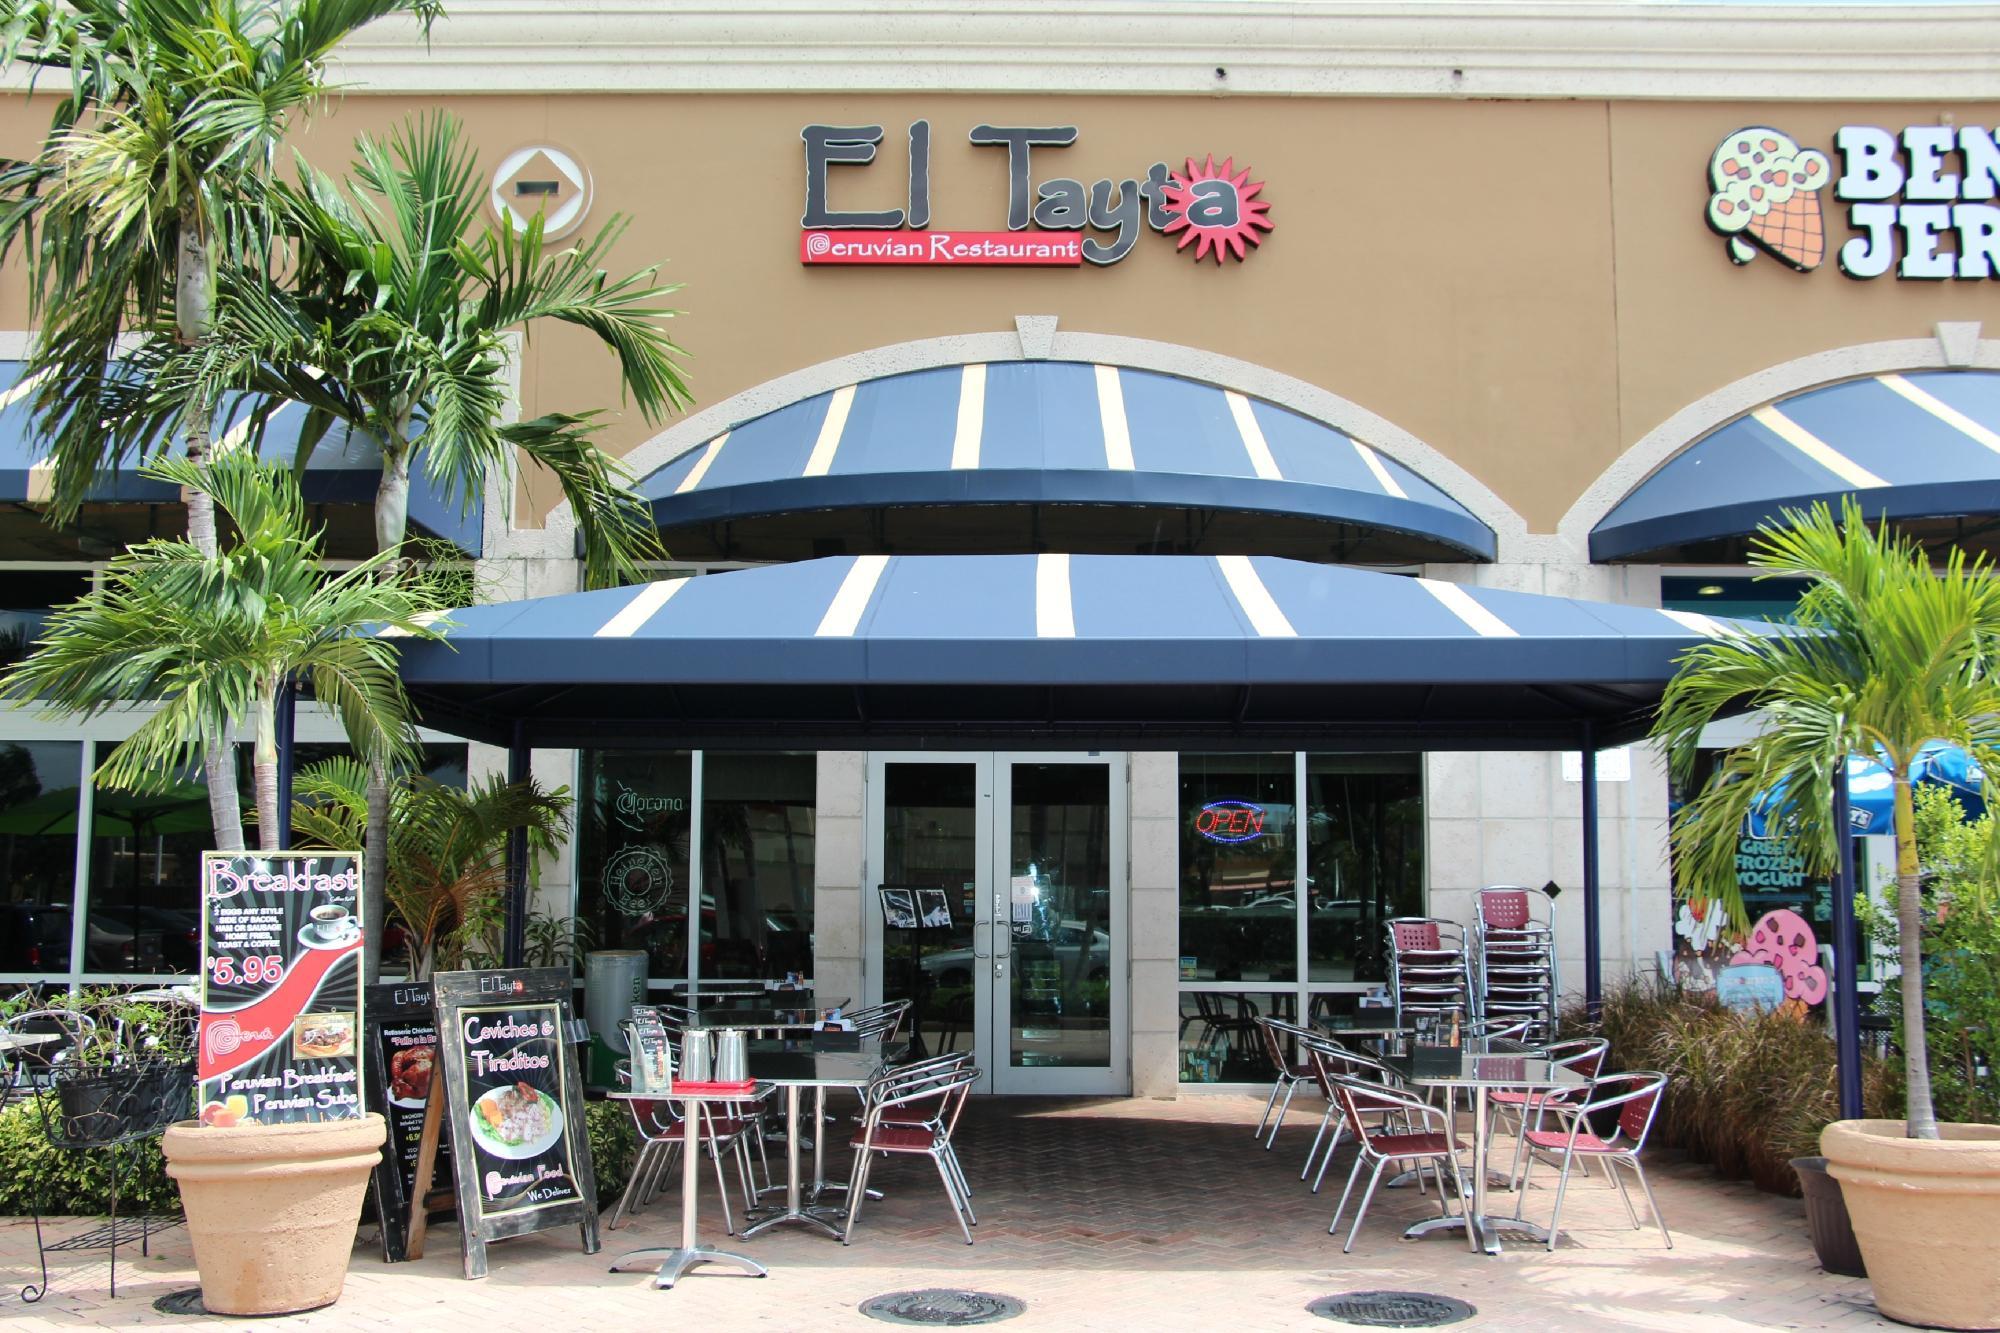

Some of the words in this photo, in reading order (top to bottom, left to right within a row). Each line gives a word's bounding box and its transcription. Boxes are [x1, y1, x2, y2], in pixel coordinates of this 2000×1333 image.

[801, 119, 930, 229] El
[969, 125, 1240, 266] Tayta
[929, 234, 1079, 260] Restaurant
[616, 792, 683, 814] Corona
[1196, 809, 1264, 833] OPEN
[1740, 840, 1796, 855] GREE
[1734, 854, 1804, 870] FROZEN
[207, 858, 359, 898] Breakfast
[1735, 872, 1808, 887] YOGURT
[218, 916, 237, 924] SIDE
[260, 907, 284, 915] STYLE
[215, 924, 233, 932] HAM
[234, 924, 246, 932] OR
[247, 923, 282, 931] SAUSAGE
[225, 932, 248, 940] HOME
[250, 939, 280, 947] COFFEE
[481, 977, 494, 993] El
[494, 975, 523, 995] Tayta
[394, 989, 408, 1004] El
[408, 987, 431, 1005] Tayt
[464, 1015, 538, 1044] Ceviches
[541, 1020, 554, 1036] &
[471, 1047, 549, 1077] Tiraditos
[220, 1072, 282, 1094] Peruvian
[284, 1065, 357, 1089] Breakfast
[253, 1093, 314, 1114] Peruvian
[315, 1087, 358, 1108] Subs
[537, 1162, 564, 1180] Food
[527, 1189, 543, 1201] We
[543, 1186, 571, 1199] Deliver
